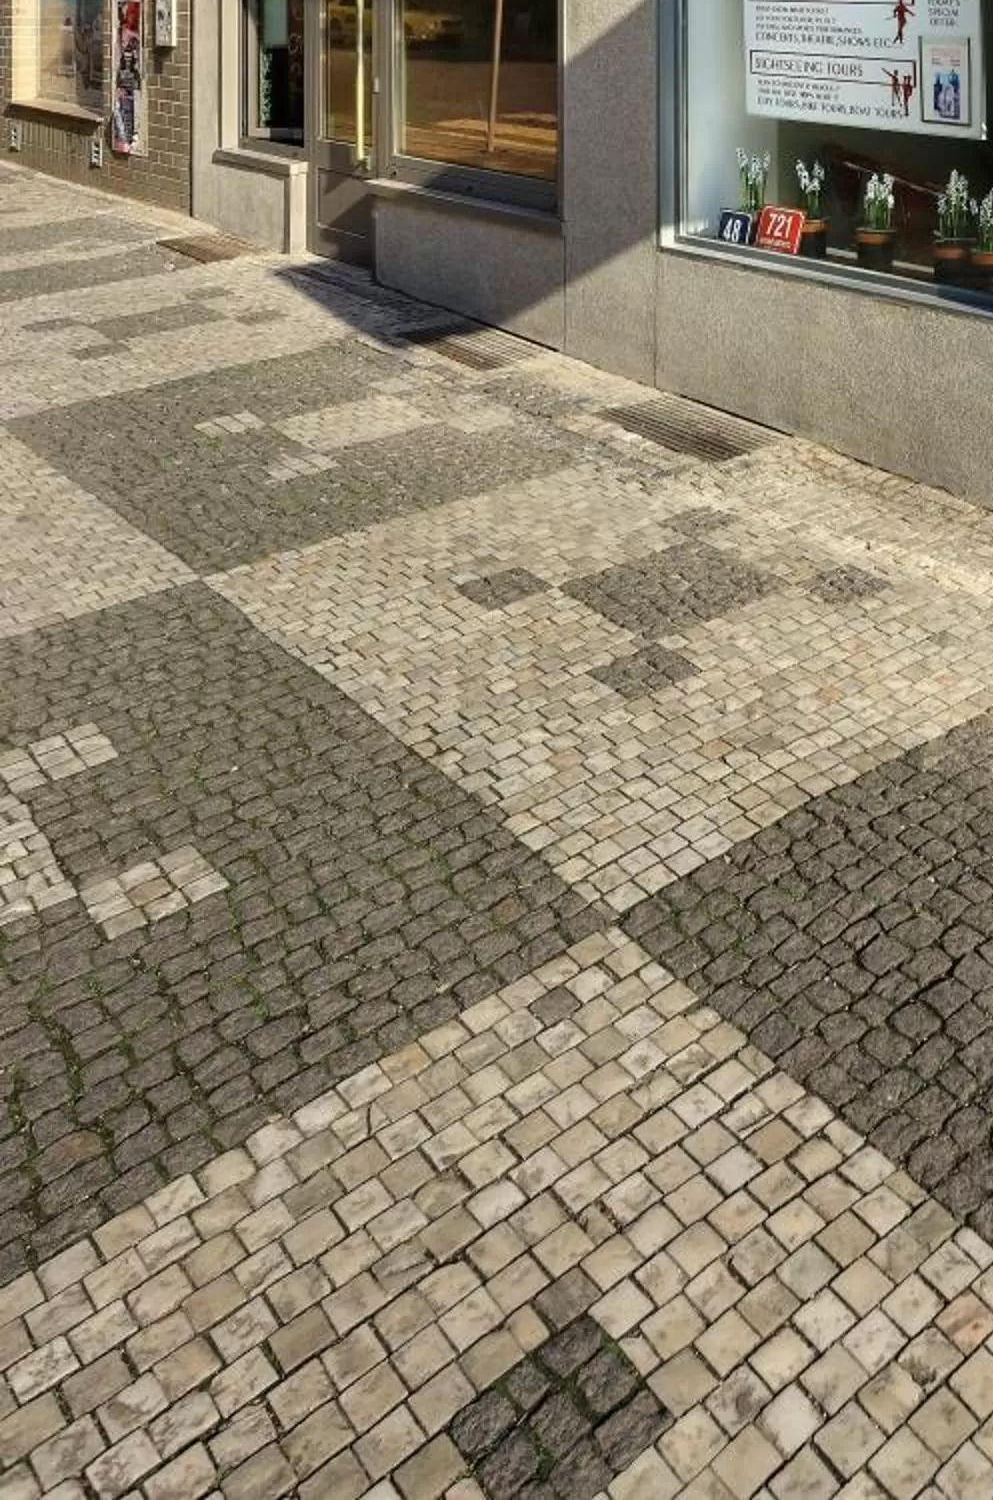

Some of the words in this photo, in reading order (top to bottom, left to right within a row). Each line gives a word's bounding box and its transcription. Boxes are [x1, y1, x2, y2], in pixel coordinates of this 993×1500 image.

[827, 61, 863, 77] TOURS
[723, 217, 741, 242] 48
[765, 213, 793, 239] 721
